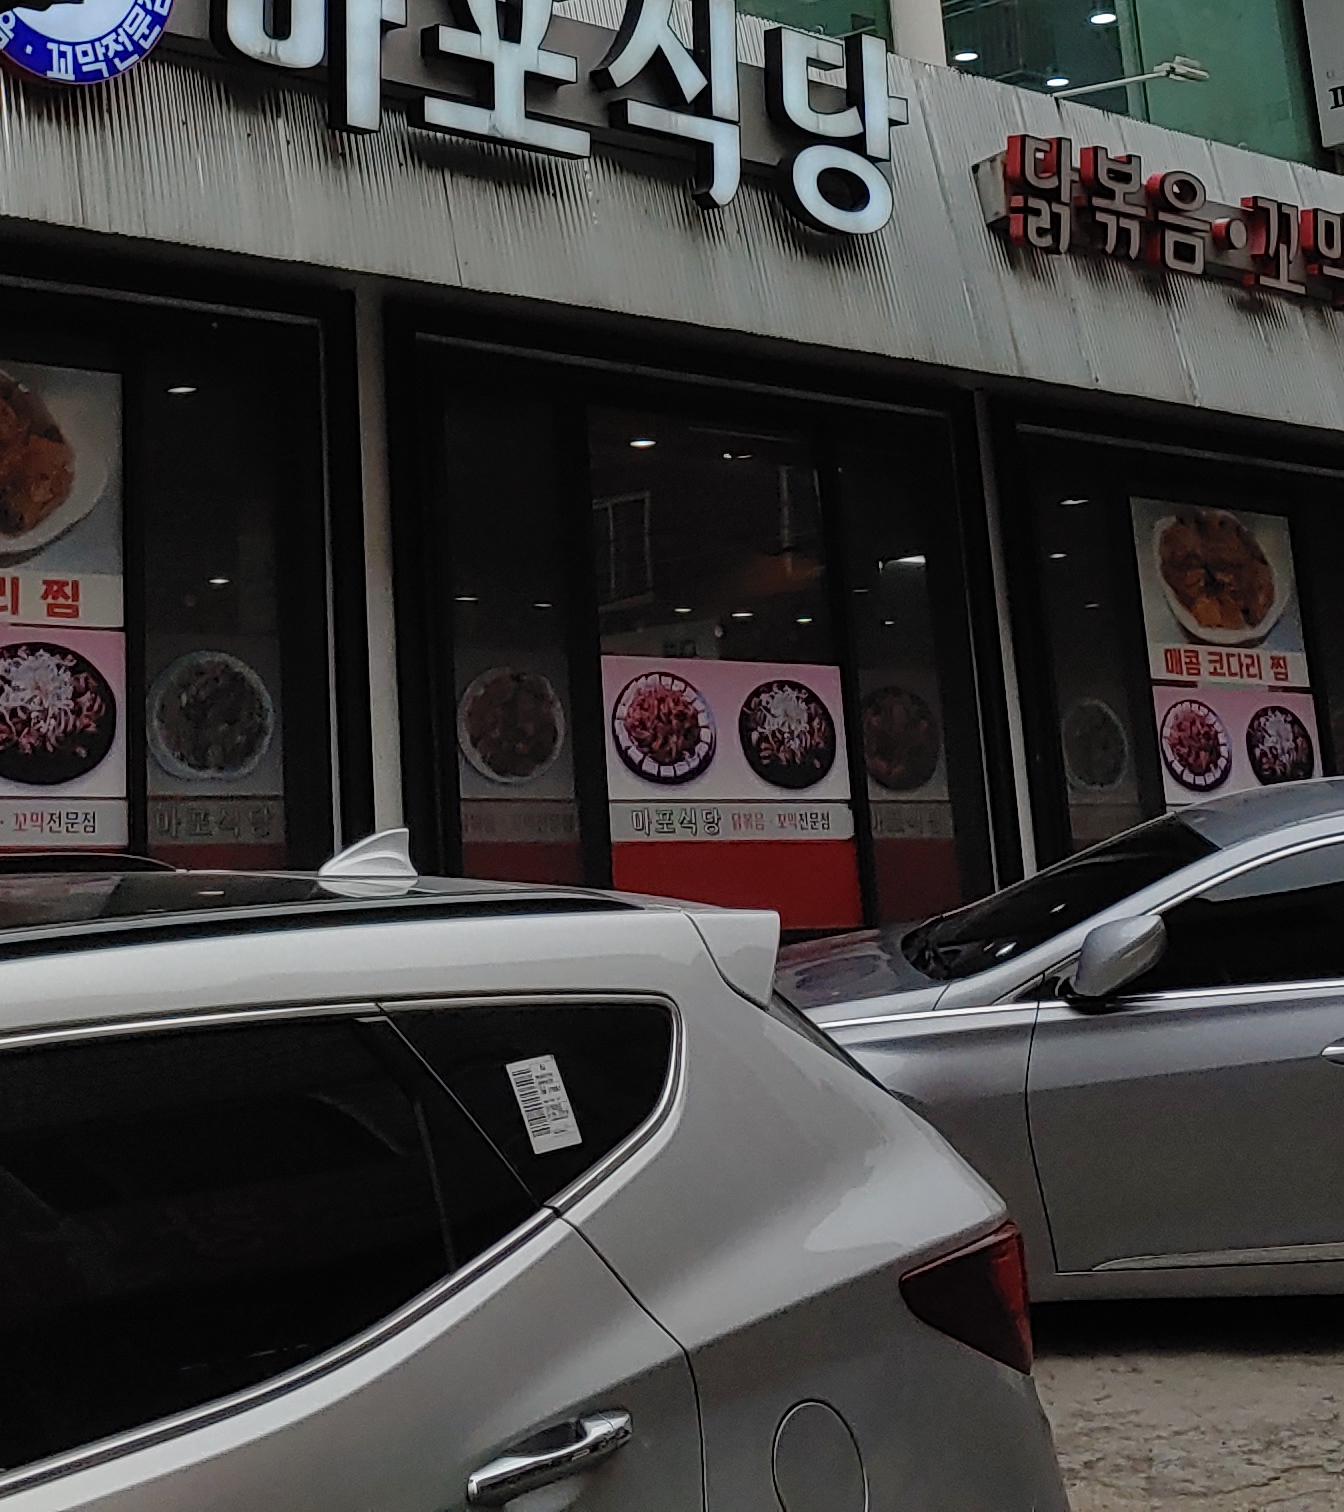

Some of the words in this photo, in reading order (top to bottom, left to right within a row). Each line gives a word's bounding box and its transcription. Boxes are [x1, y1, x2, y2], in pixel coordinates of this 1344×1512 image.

[40, 578, 80, 620] 찜
[1164, 648, 1202, 677] 매콤
[1206, 651, 1263, 681] 코다리
[11, 810, 97, 835] 꼬막전문점
[631, 807, 722, 836] 마포식당
